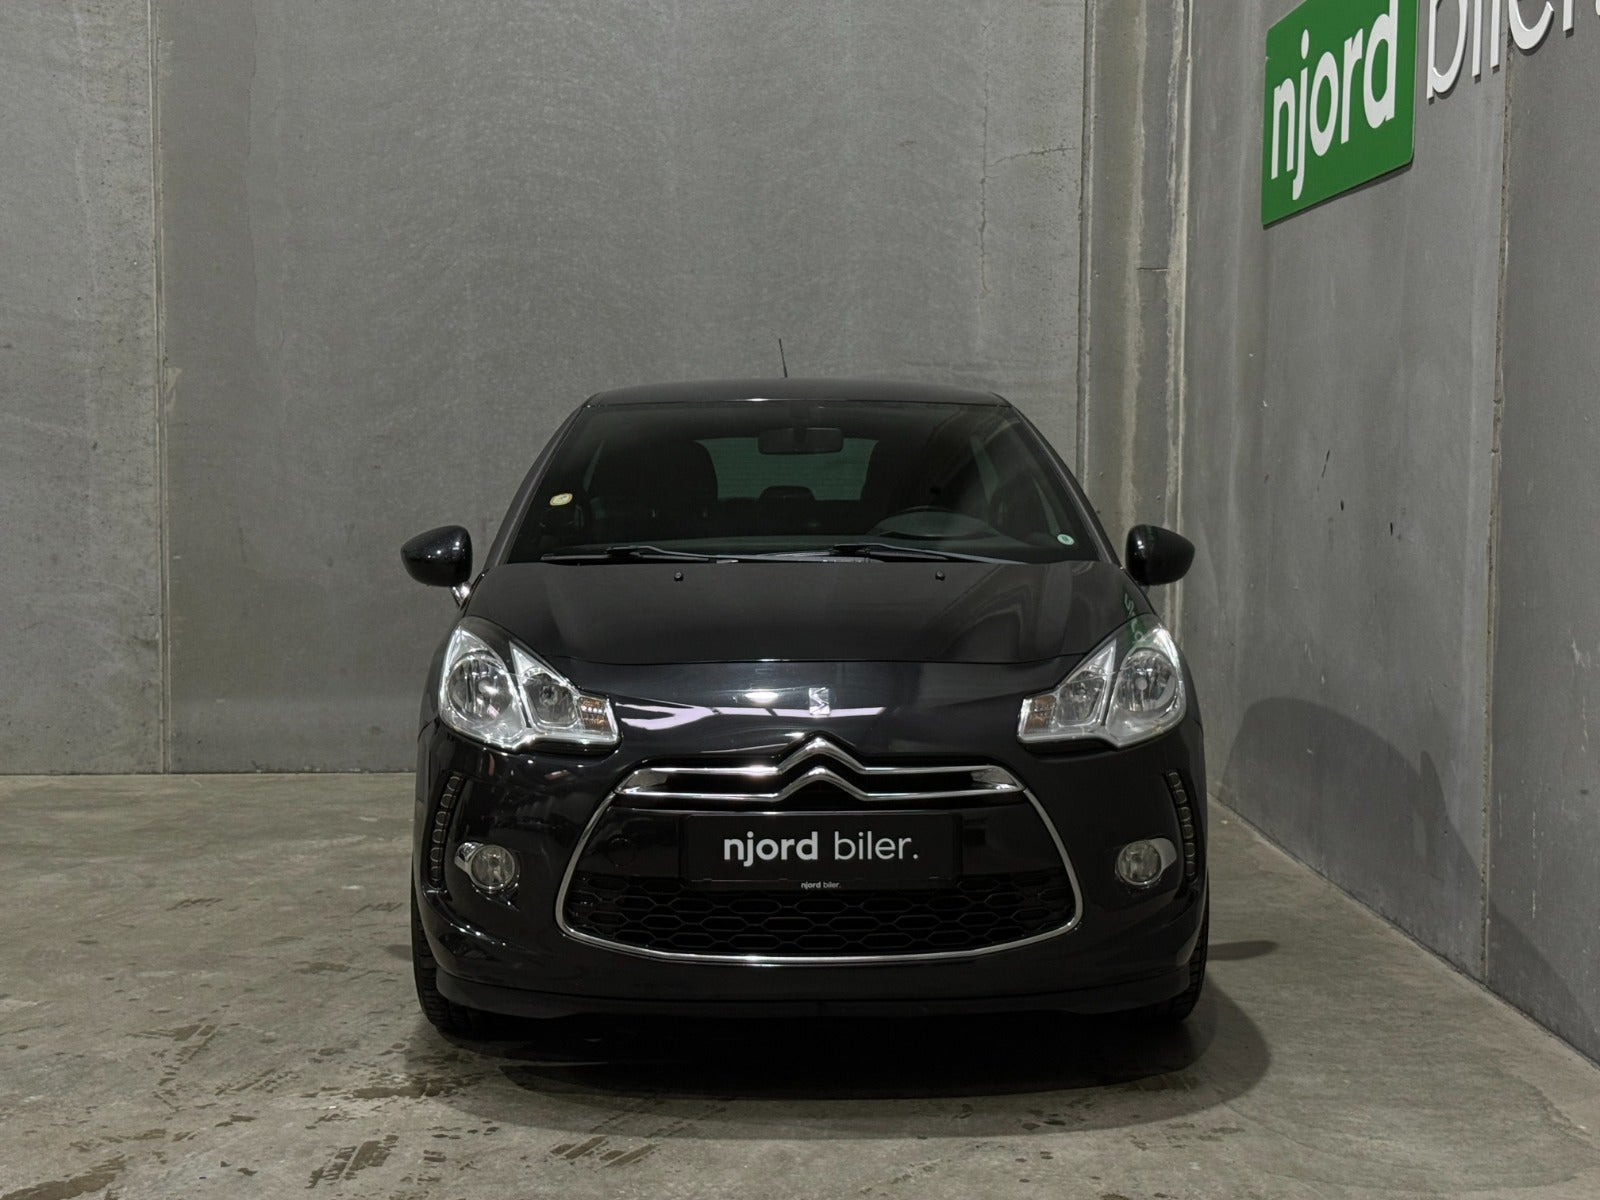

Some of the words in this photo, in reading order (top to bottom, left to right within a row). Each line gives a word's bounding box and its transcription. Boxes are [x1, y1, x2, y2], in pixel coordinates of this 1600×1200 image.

[1271, 0, 1398, 200] njord
[724, 830, 818, 867] njord
[834, 830, 919, 860] biler.
[800, 881, 821, 889] njord
